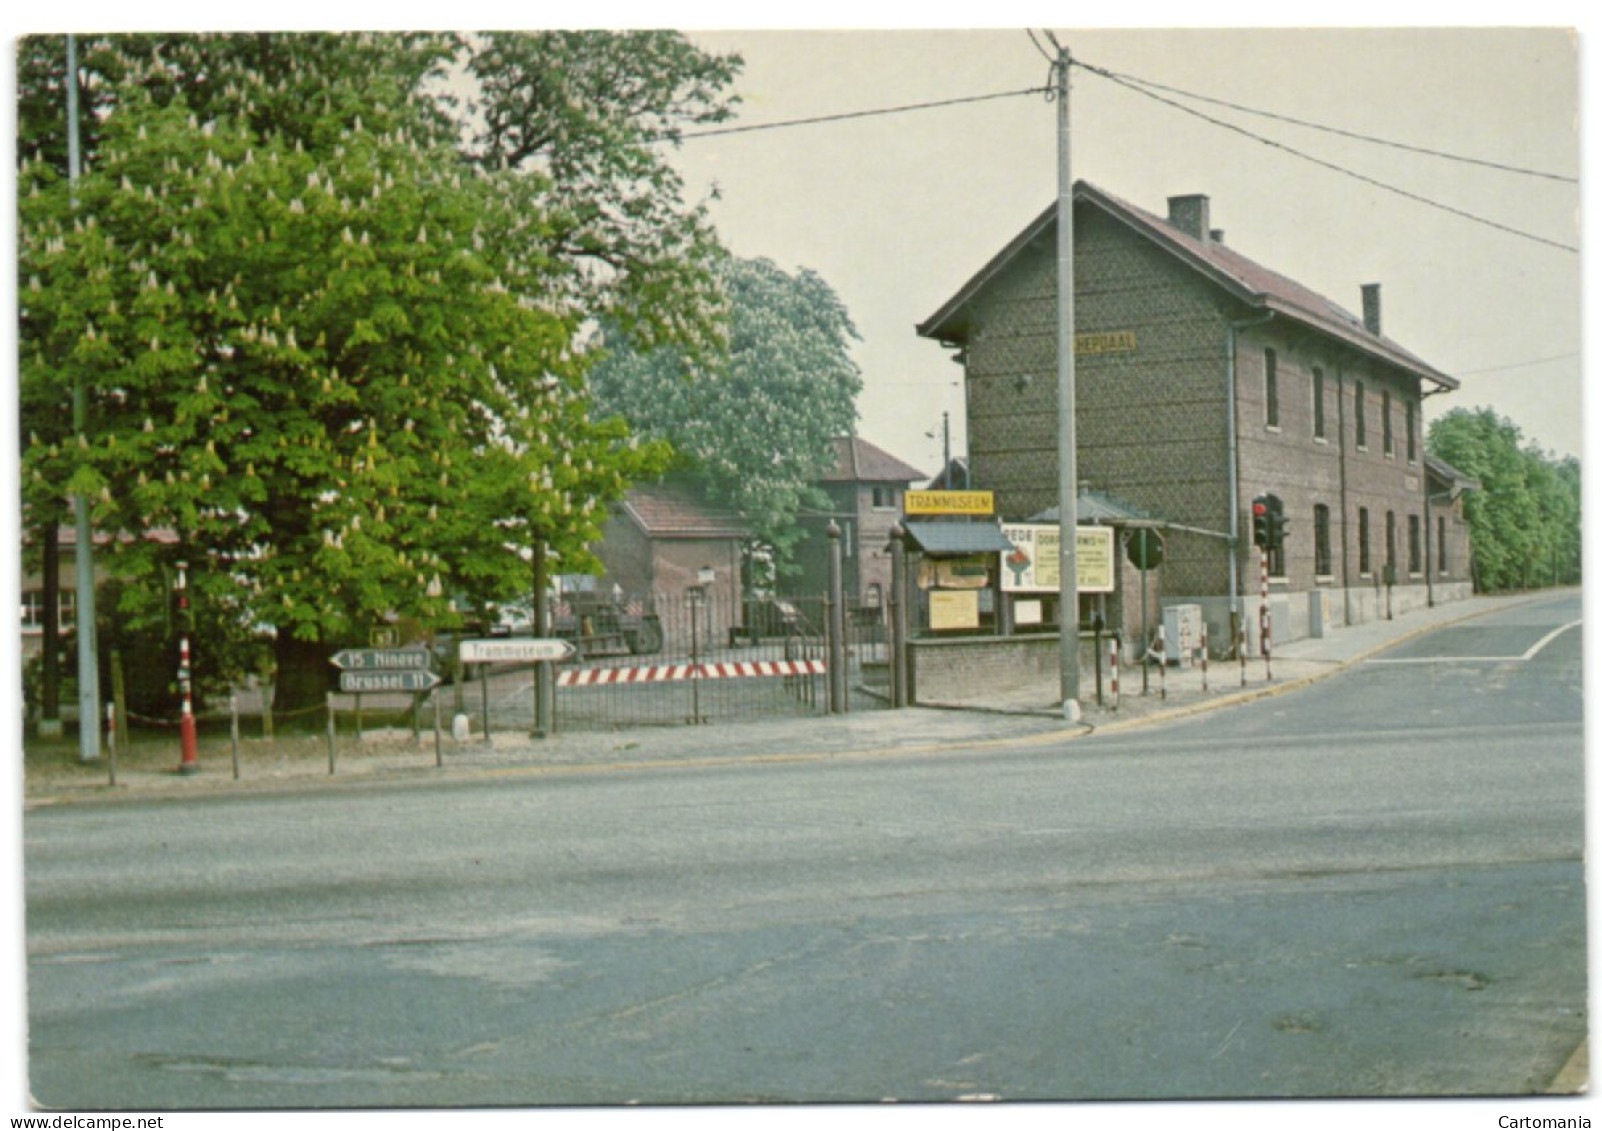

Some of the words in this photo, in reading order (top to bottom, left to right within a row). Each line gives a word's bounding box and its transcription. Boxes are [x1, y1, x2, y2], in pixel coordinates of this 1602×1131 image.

[1075, 331, 1134, 353] HEPDAAL
[345, 672, 403, 689] Brussel
[412, 672, 424, 689] 11
